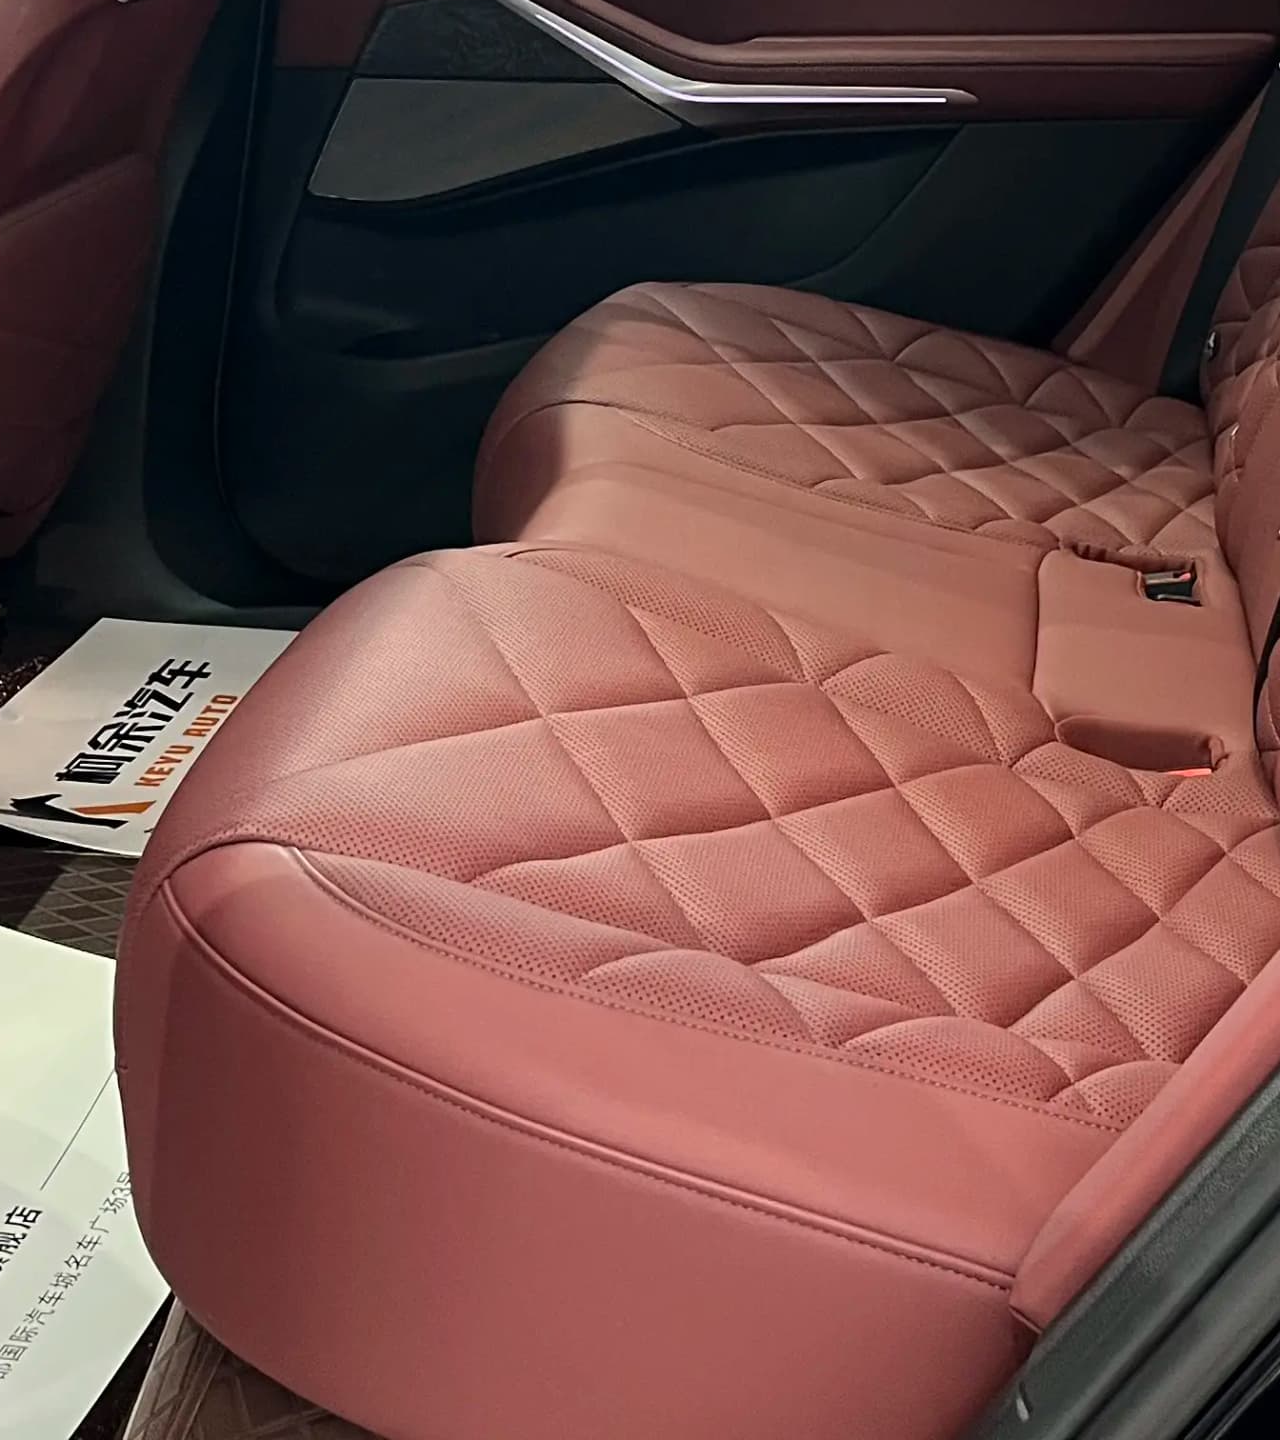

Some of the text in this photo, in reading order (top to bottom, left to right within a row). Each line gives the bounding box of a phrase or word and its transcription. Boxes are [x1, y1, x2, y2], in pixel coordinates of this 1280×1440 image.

[54, 658, 212, 785] 柯余汽车
[134, 694, 239, 788] KEYU AUTO
